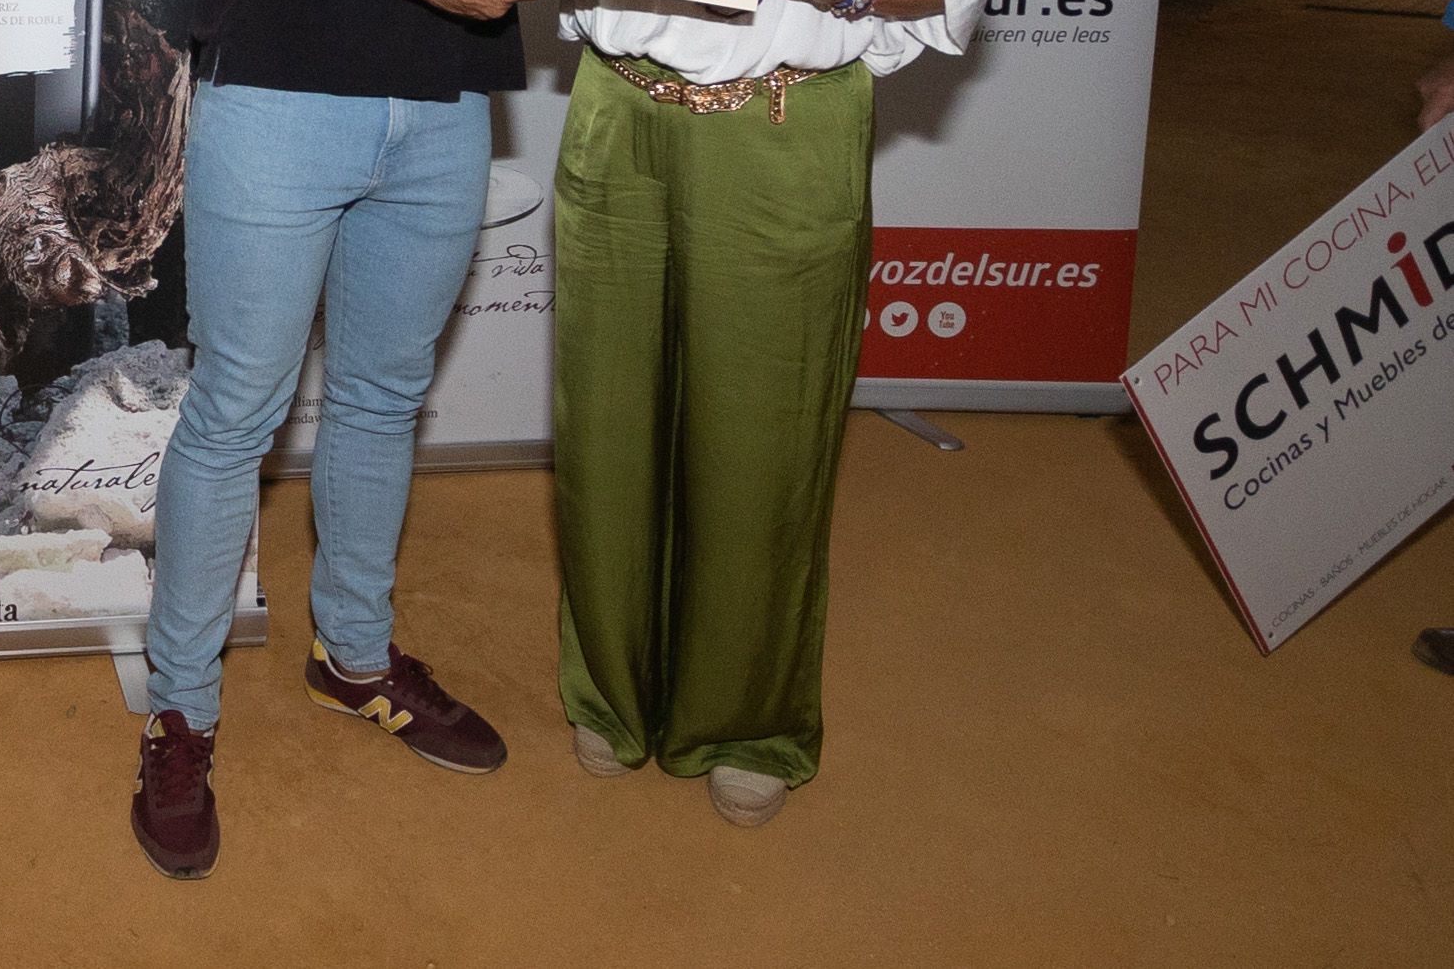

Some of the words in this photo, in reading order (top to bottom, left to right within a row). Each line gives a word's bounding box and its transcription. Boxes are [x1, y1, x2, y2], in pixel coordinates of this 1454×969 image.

[9, 15, 25, 26] DE
[27, 15, 63, 26] ROBLE
[1031, 29, 1068, 47] que
[1071, 26, 1112, 43] leas
[1154, 320, 1239, 395] PARA
[1239, 281, 1278, 327] MI
[1283, 182, 1415, 290] COCINA,
[1223, 432, 1314, 511] Cocinas
[1315, 415, 1330, 444] y
[1333, 338, 1428, 421] Muebles
[1272, 588, 1316, 628] COCINAS
